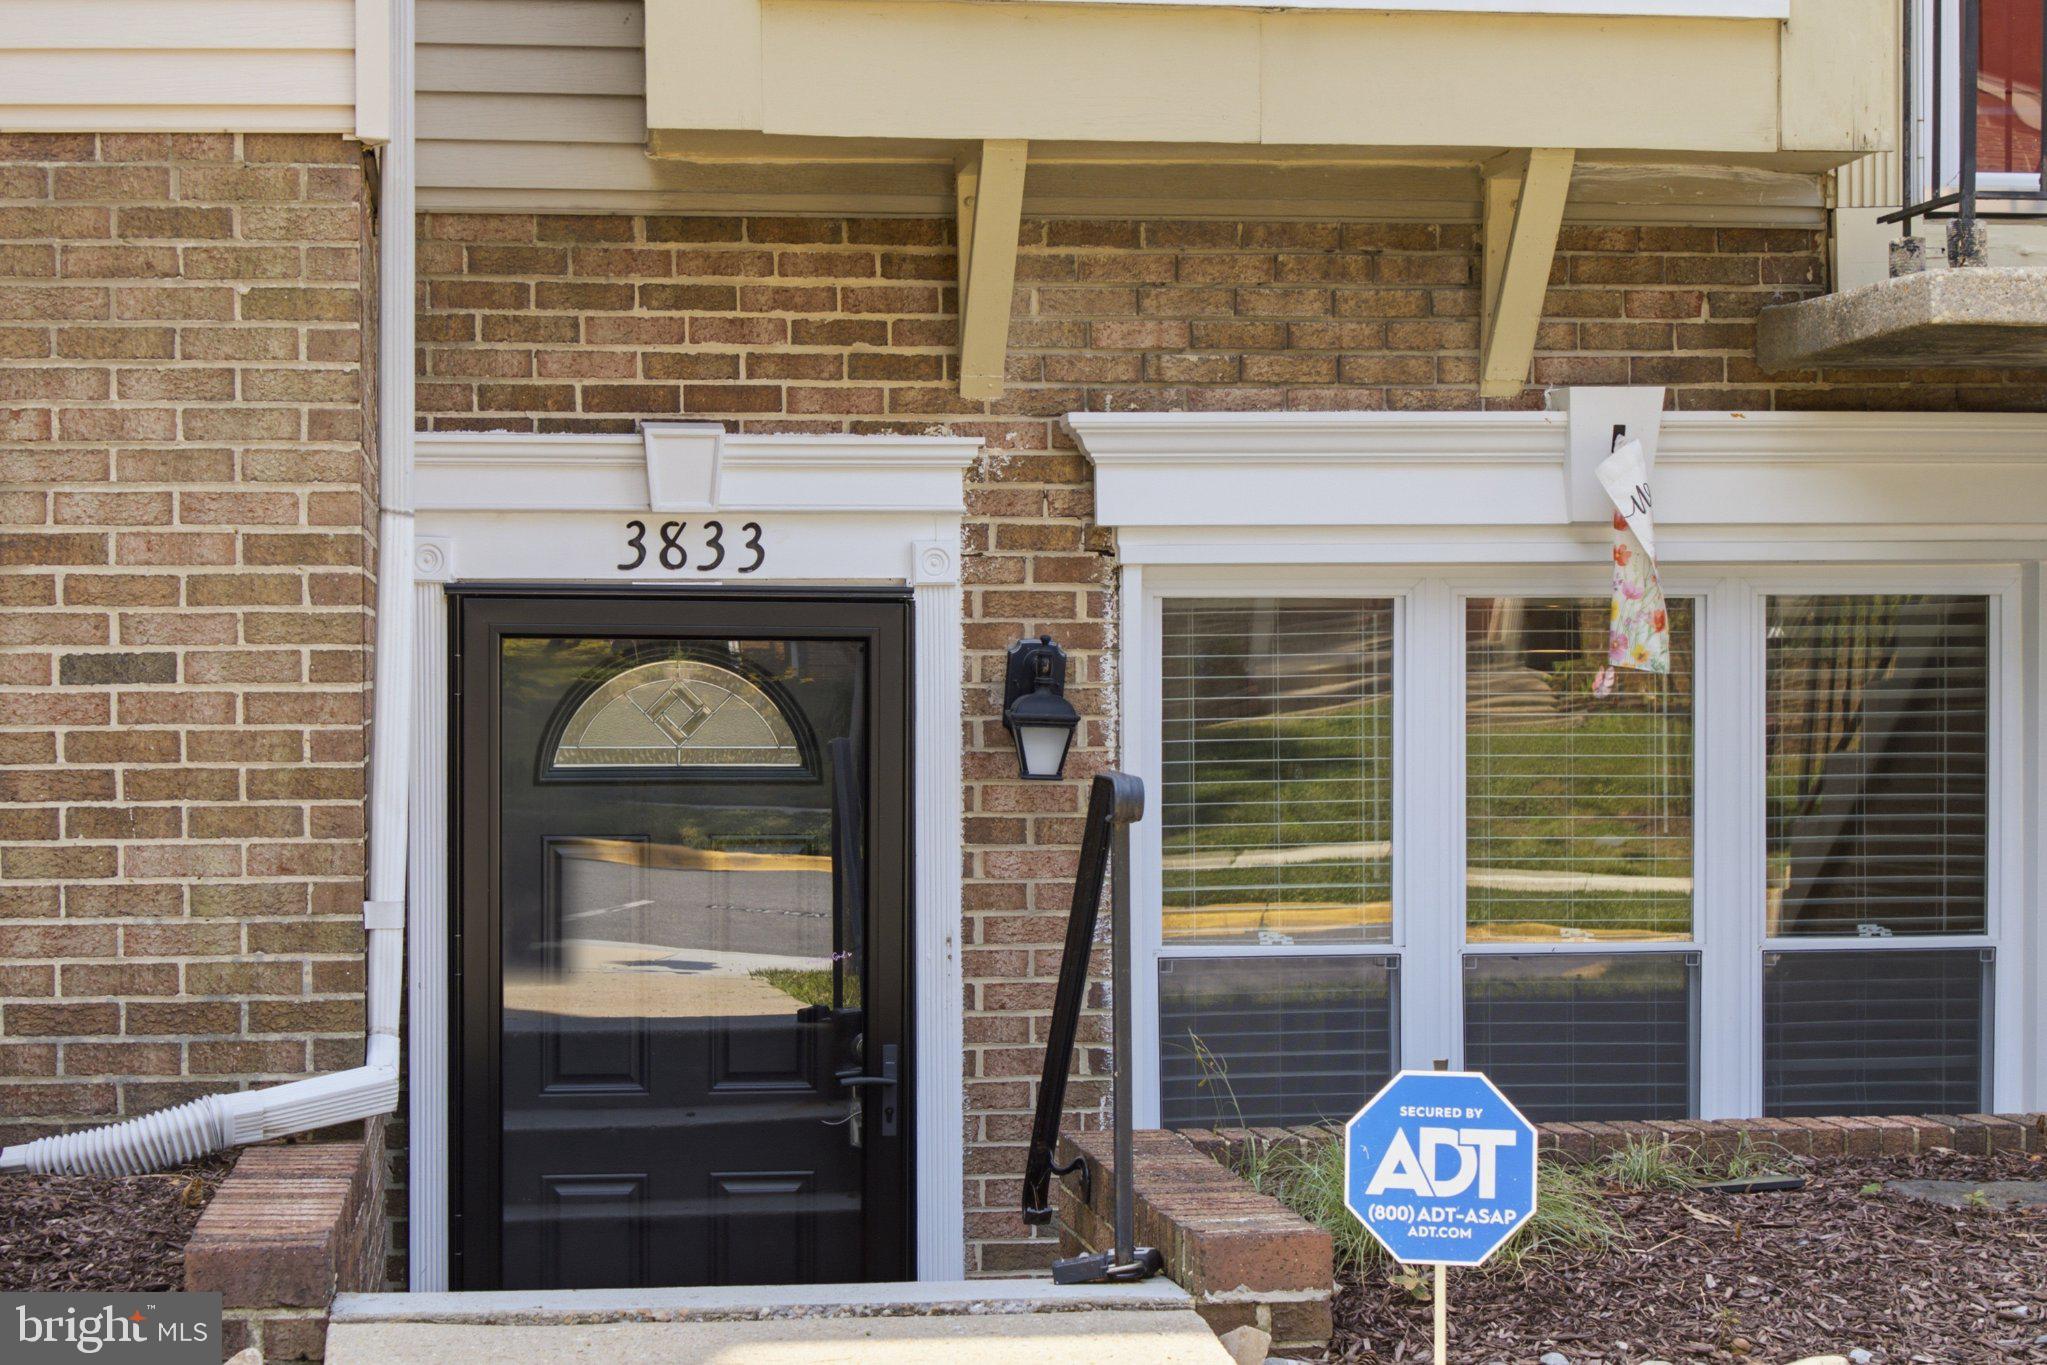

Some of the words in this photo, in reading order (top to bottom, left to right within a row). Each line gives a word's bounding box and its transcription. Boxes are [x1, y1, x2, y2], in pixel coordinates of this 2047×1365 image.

[617, 520, 765, 573] 3833
[1400, 1106, 1462, 1118] SECURED
[1466, 1108, 1483, 1119] BY
[1365, 1126, 1517, 1199] ADT
[1368, 1203, 1415, 1223] (800)
[1417, 1206, 1517, 1225] ADT-ASAP
[1407, 1226, 1472, 1239] ADT.COM
